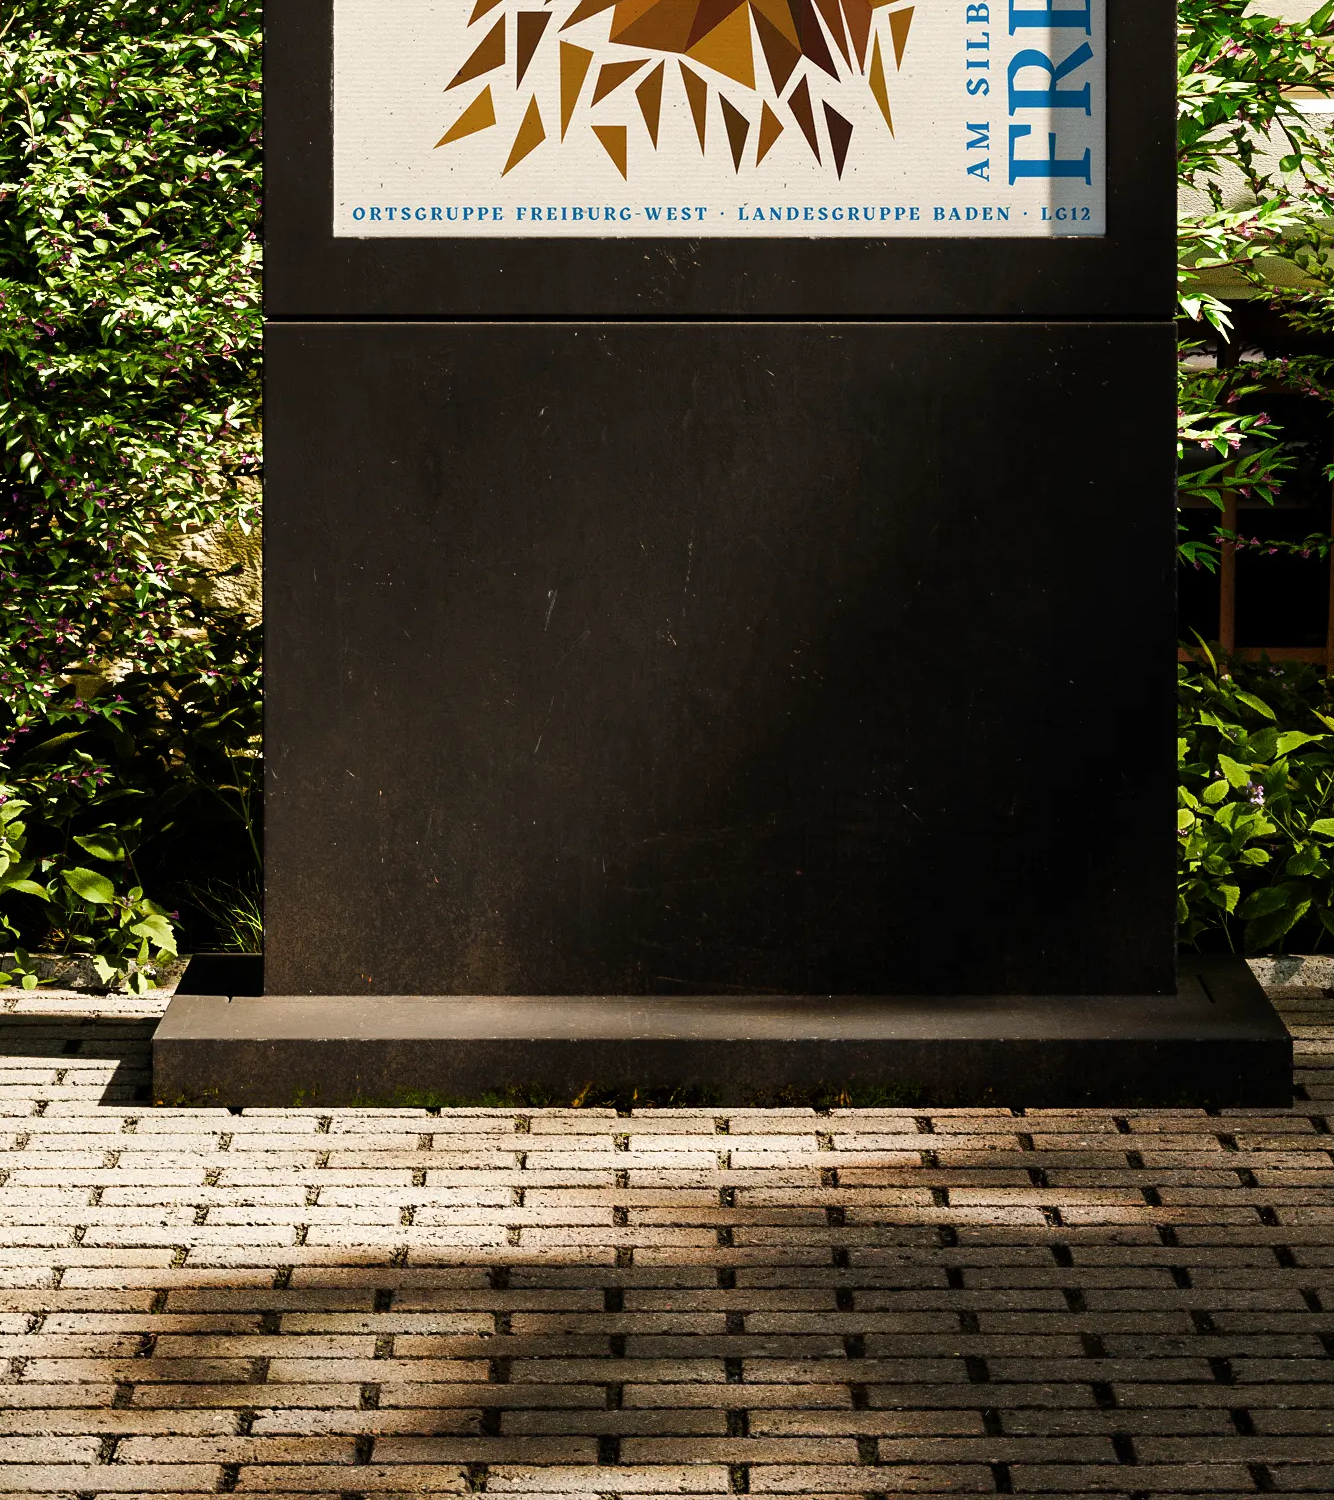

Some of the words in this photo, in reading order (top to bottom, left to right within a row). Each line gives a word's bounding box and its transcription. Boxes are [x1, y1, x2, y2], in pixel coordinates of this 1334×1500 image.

[965, 121, 990, 182] AM
[352, 206, 504, 221] ORTSGRUPPE
[516, 206, 708, 221] FREIBURG-WEST
[738, 206, 920, 221] LANDESGRUPPE
[933, 206, 1010, 221] BADEN
[1041, 206, 1091, 221] LG12
